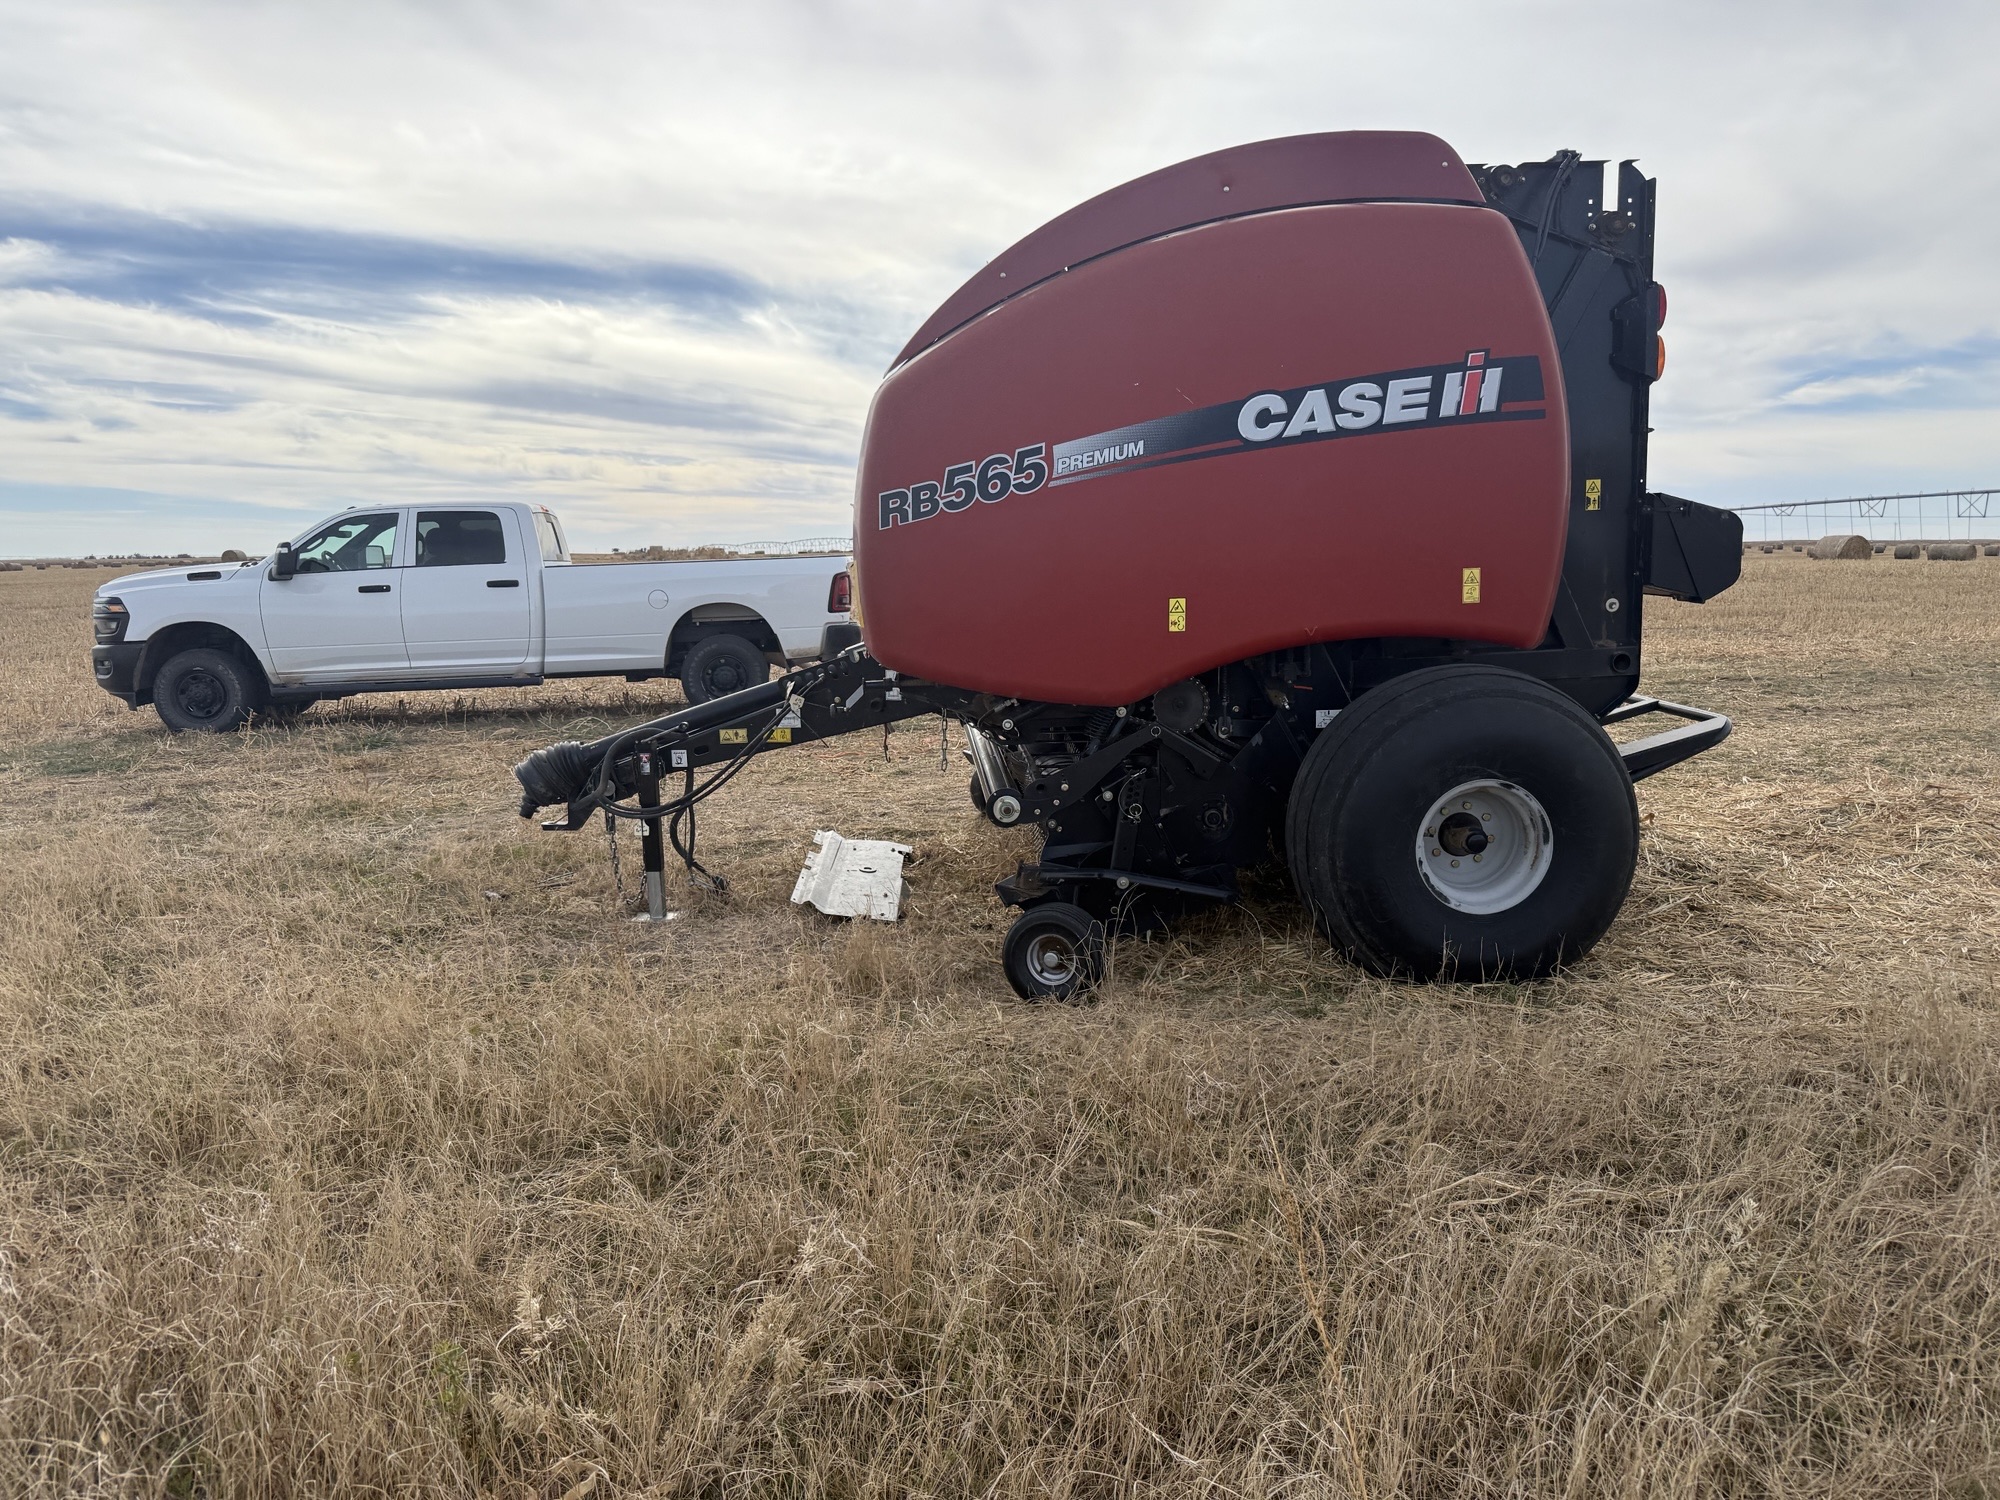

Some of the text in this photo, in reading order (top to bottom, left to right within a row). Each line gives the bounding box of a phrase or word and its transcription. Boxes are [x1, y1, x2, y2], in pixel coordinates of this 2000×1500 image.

[1237, 374, 1433, 443] CASE
[878, 440, 1145, 531] RB565 PREMIUM
